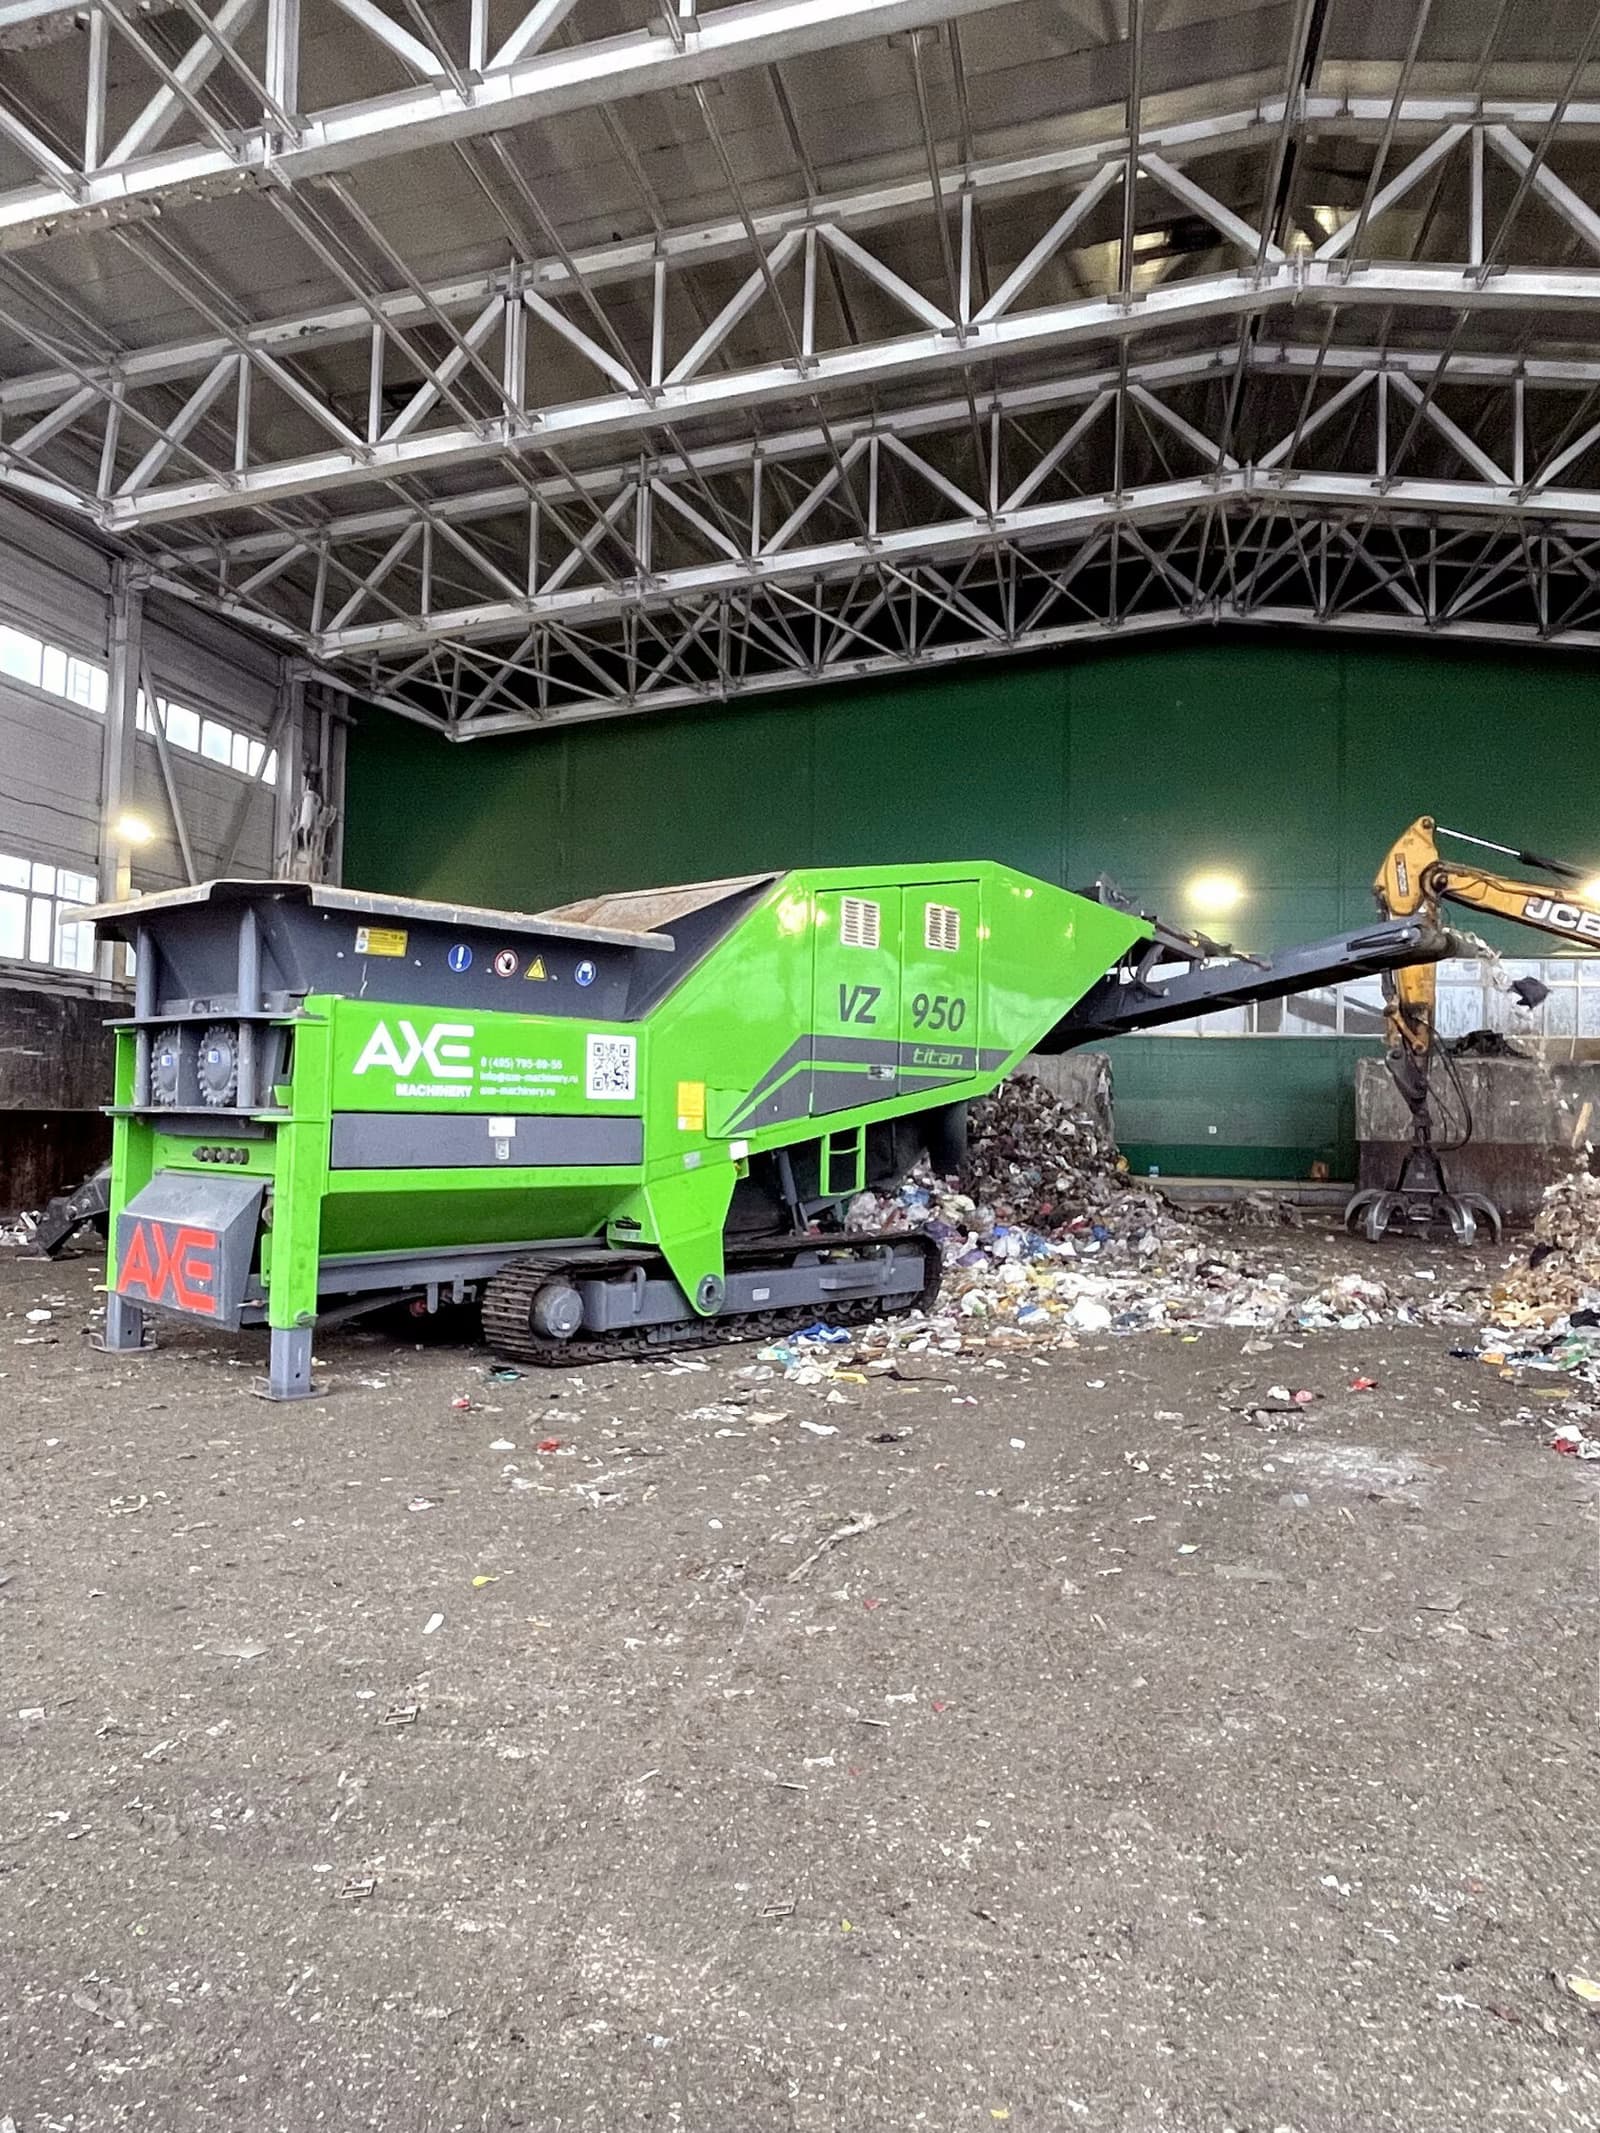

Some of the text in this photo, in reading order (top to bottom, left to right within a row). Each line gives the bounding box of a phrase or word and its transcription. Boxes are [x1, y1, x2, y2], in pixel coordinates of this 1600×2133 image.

[1525, 897, 1600, 938] JCB
[839, 983, 881, 1024] VZ
[912, 993, 966, 1032] 950
[352, 1020, 474, 1078] AXE
[913, 1048, 963, 1066] titan
[395, 1083, 473, 1098] MACHINERY
[117, 1221, 216, 1314] AXE
